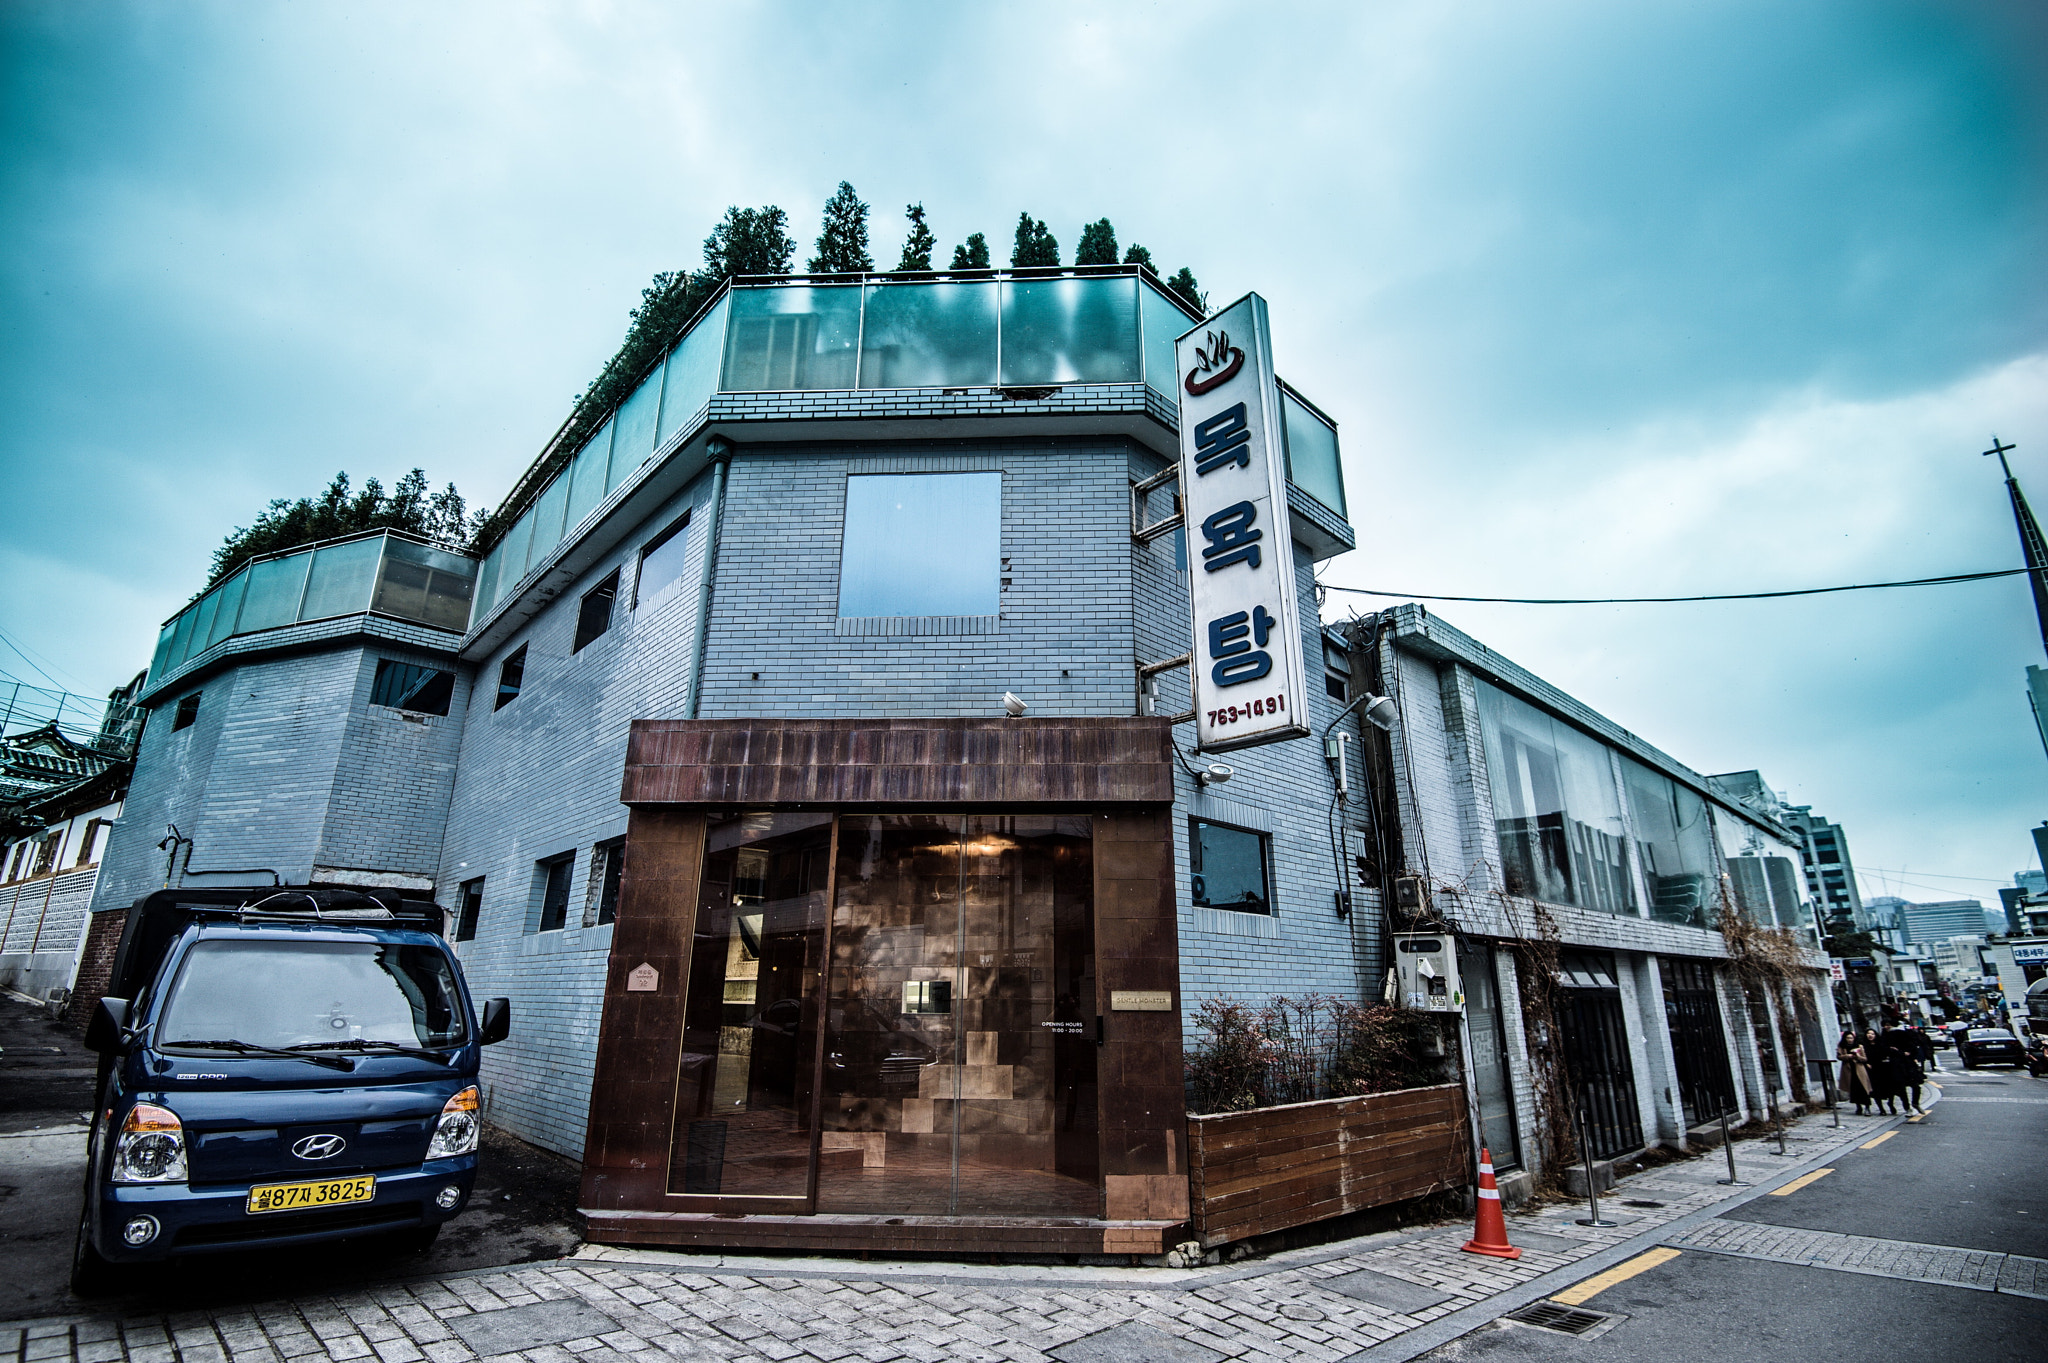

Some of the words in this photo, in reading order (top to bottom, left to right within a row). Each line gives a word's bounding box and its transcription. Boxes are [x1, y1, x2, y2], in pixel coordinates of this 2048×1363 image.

[1193, 401, 1276, 687] 목욕탕
[1207, 694, 1285, 728] 763-1491
[315, 1181, 366, 1203] 3825
